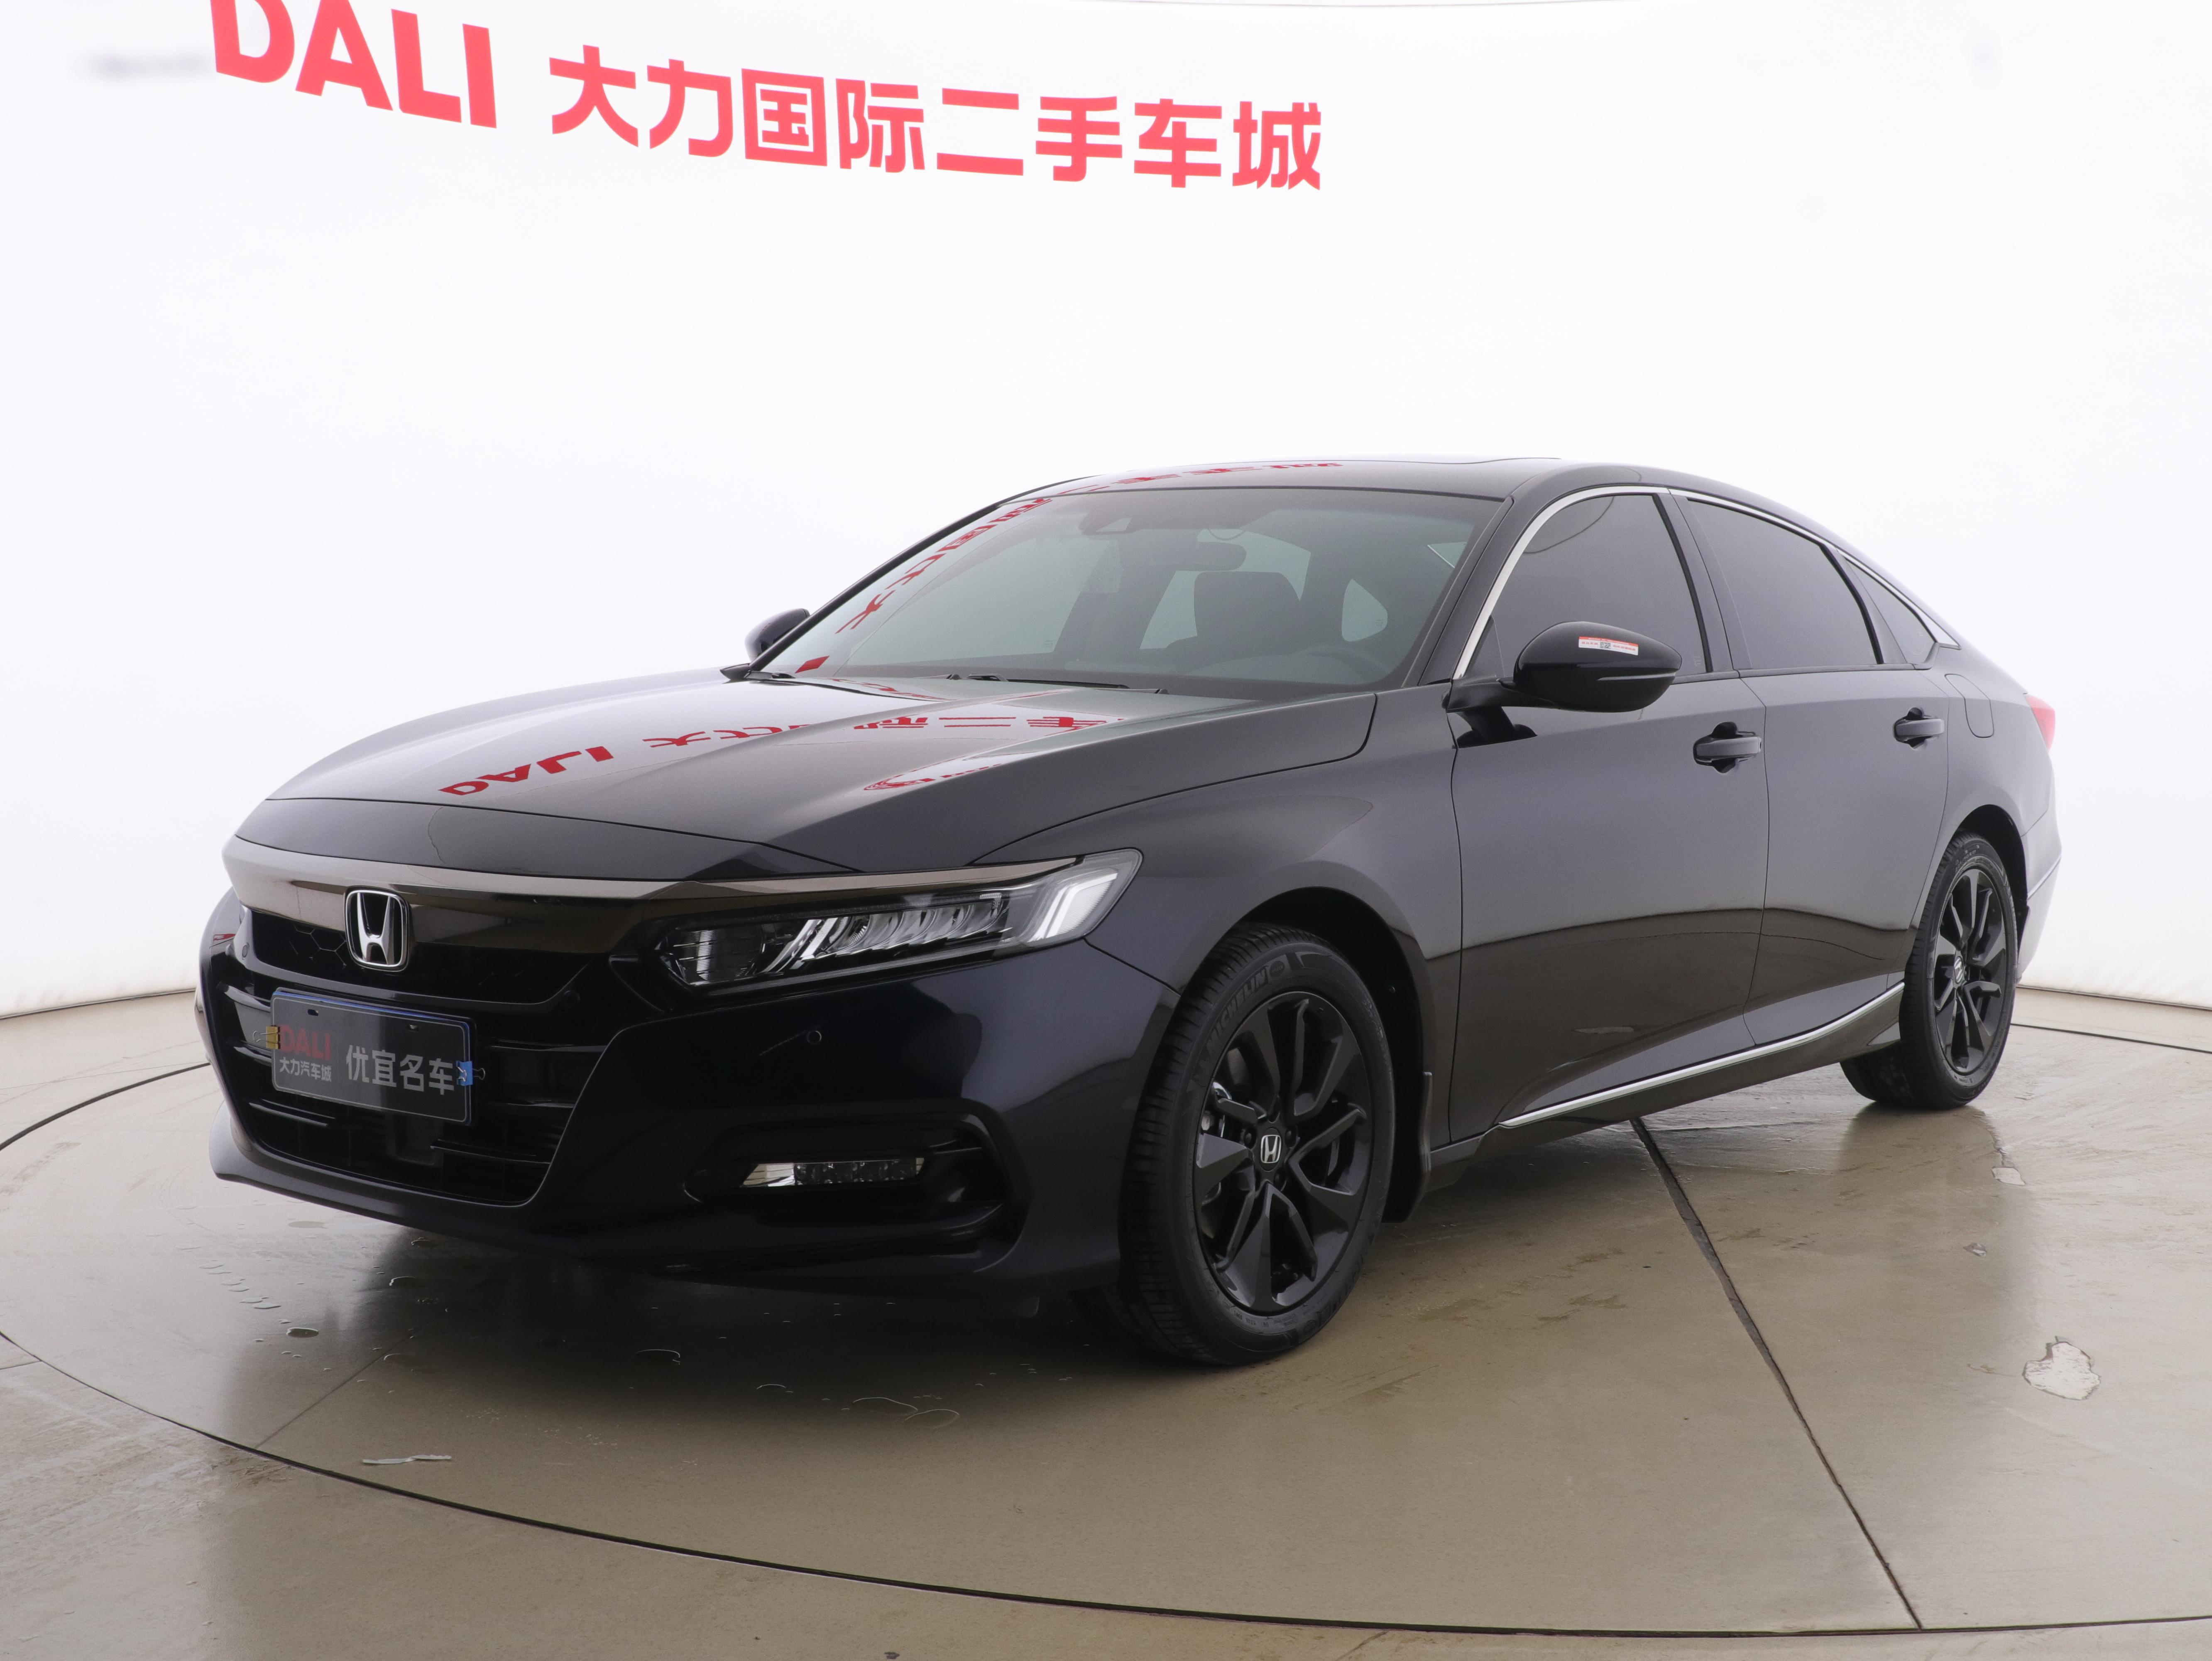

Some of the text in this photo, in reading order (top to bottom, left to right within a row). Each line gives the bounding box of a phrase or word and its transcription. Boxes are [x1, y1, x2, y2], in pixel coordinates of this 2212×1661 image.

[210, 0, 1321, 190] DALI 大力国际二手车城
[1206, 968, 1266, 1057] MICHELIN
[279, 1025, 331, 1061] DALI
[279, 1056, 332, 1082] 大力汽车城
[346, 1045, 455, 1095] 优宜名车
